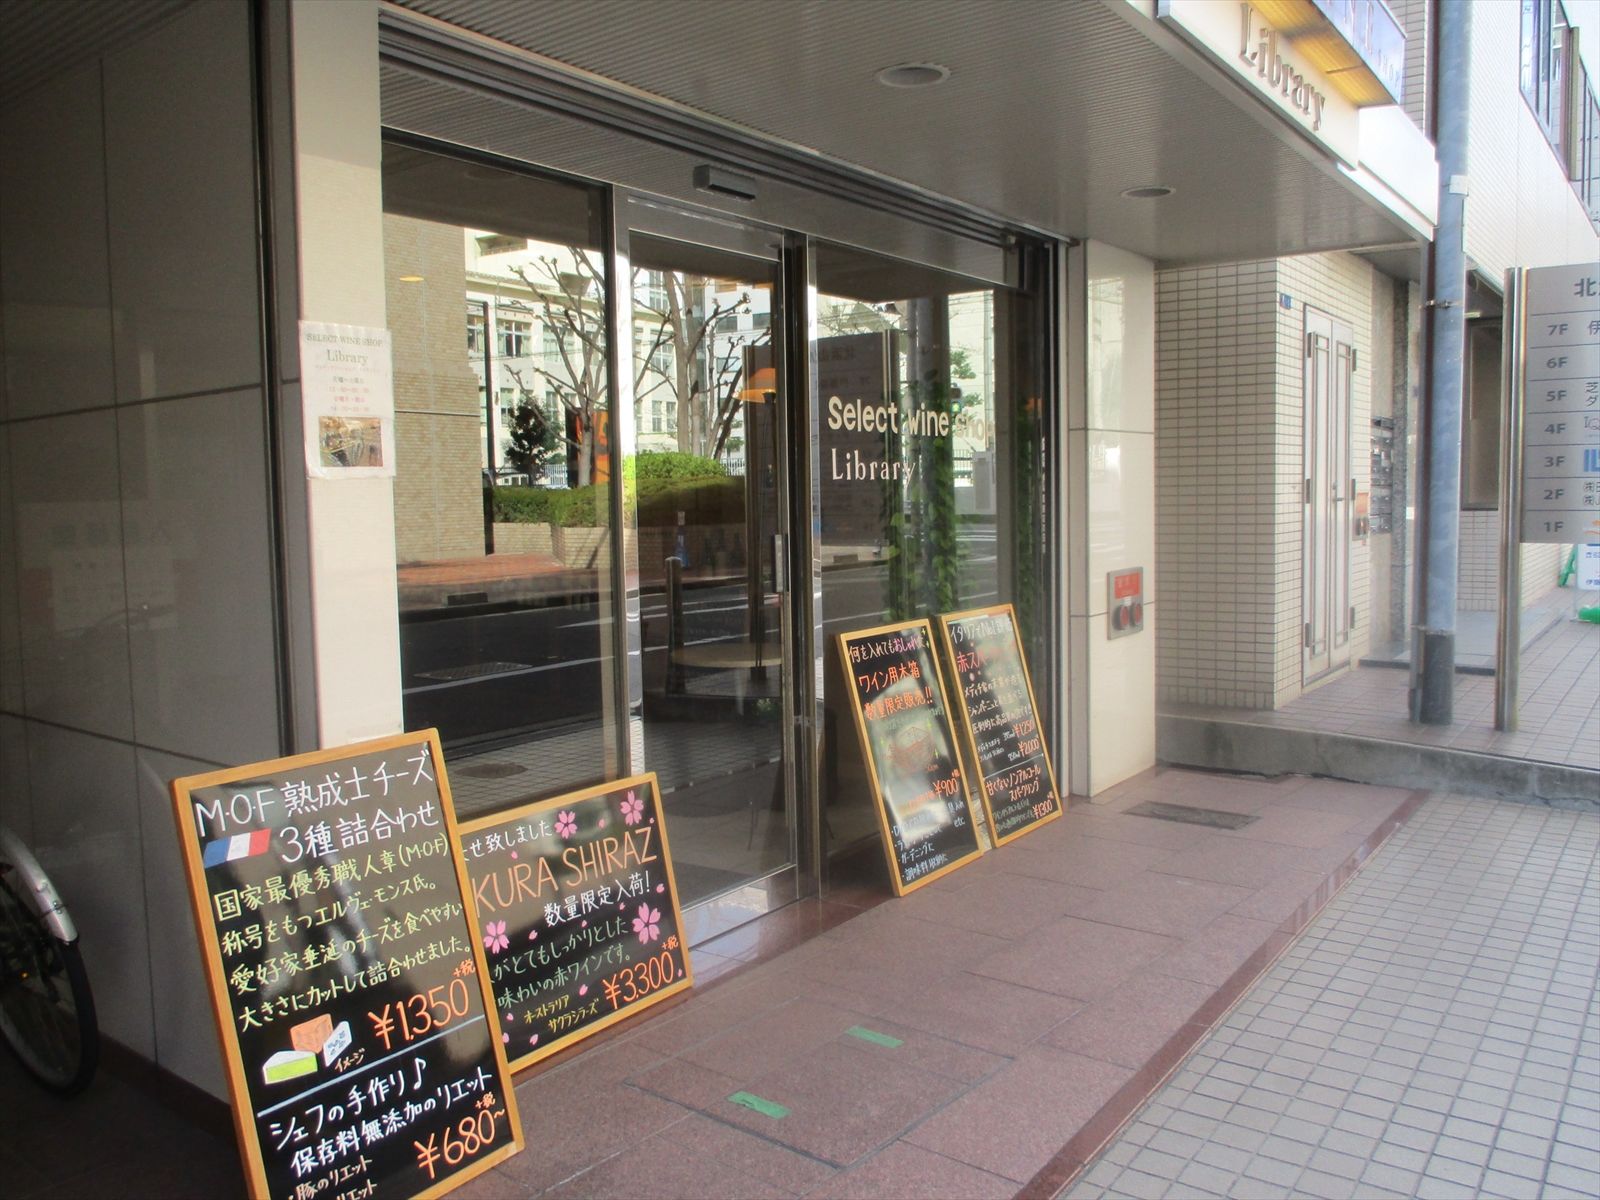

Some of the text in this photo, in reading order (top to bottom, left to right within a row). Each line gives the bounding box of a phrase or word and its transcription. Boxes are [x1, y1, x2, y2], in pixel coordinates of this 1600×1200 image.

[1238, 3, 1325, 131] Library
[1574, 278, 1600, 297] 北
[339, 335, 361, 345] WINE
[1547, 324, 1568, 336] 7F
[327, 350, 369, 366] Library
[1546, 357, 1568, 369] 6F
[1546, 390, 1567, 401] 5F
[828, 396, 898, 434] Select
[908, 402, 949, 436] wine
[1544, 423, 1566, 434] 4F
[832, 448, 916, 488] Library
[1544, 456, 1565, 467] 3F
[1544, 488, 1565, 500] 2F
[1544, 521, 1564, 533] 1F
[858, 660, 921, 694] ワイン用木箱
[1010, 778, 1040, 803] スパークリング
[279, 800, 439, 864] 3種詰合わせ
[562, 826, 657, 888] SHIRAZ
[543, 870, 651, 927] 数量限定入荷!
[489, 916, 629, 984] がとてもしっかりとした
[497, 942, 631, 1010] 味わいの赤ワインです。
[523, 994, 570, 1025] オーストラリア
[548, 997, 599, 1034] サクラシラーズ
[335, 1047, 365, 1073] イメージ
[290, 1066, 492, 1178] 保存料無添加のリエット
